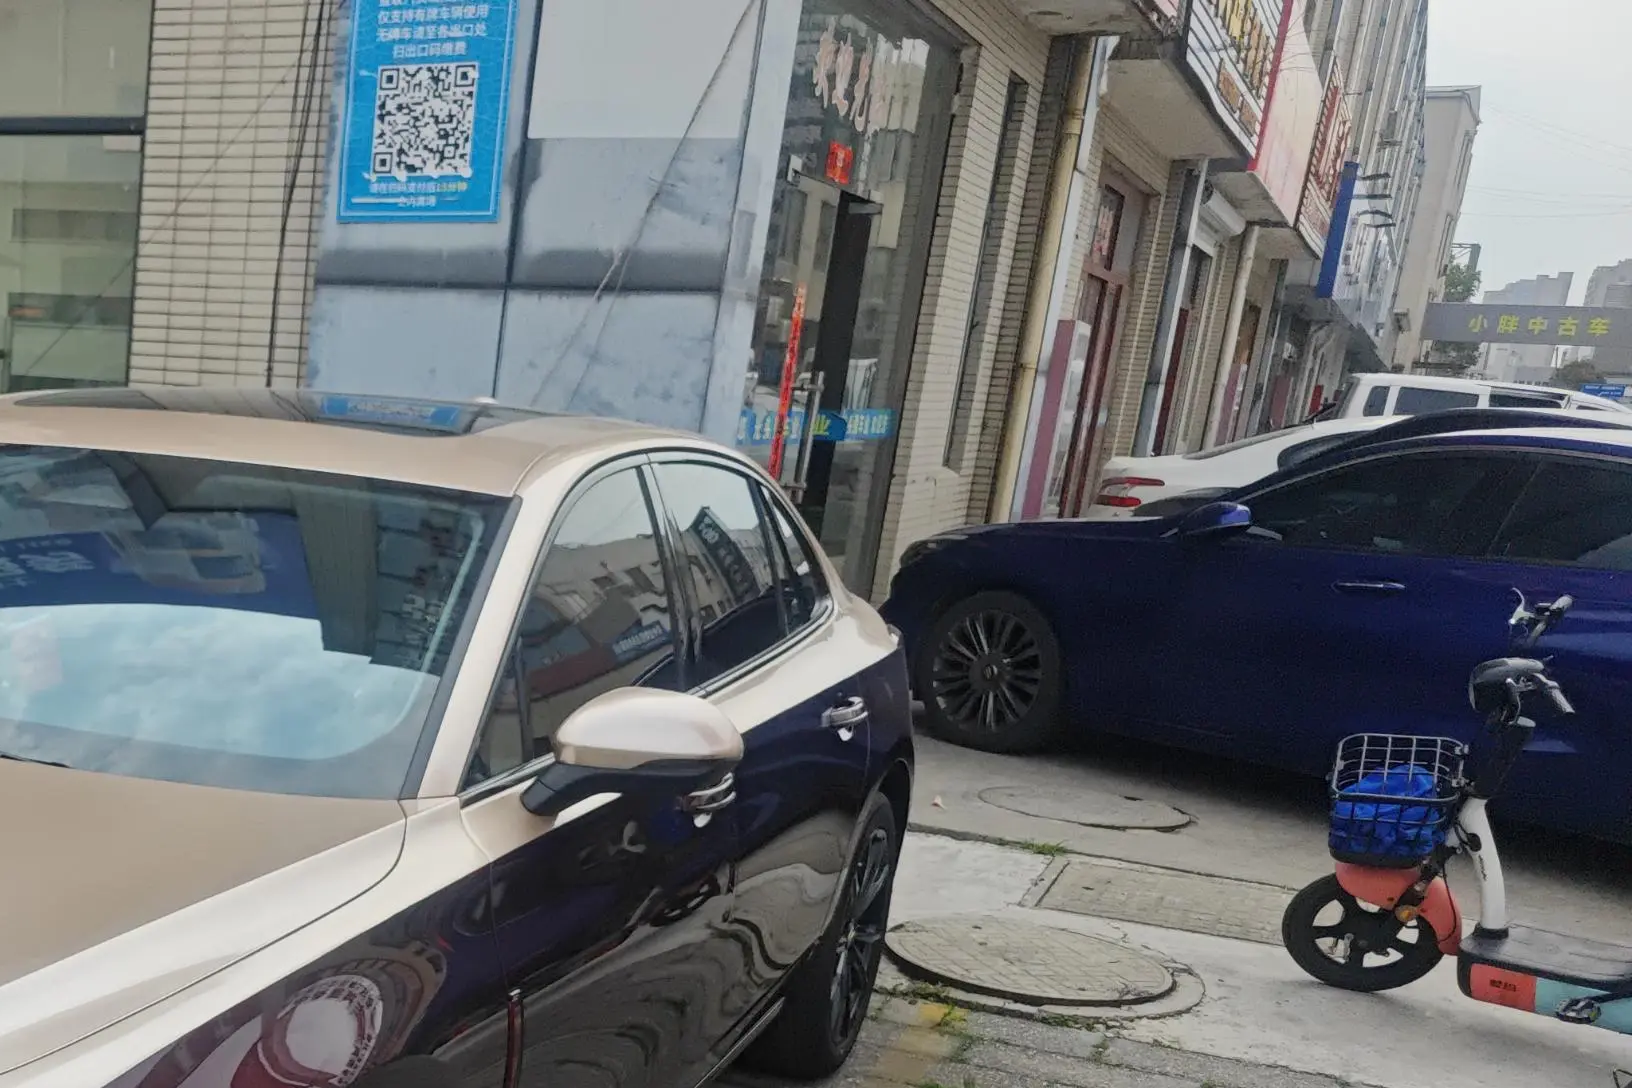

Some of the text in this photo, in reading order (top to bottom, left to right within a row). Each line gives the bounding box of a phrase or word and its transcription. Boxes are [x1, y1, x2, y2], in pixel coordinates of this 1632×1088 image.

[1469, 314, 1611, 336] 小胖中古车
